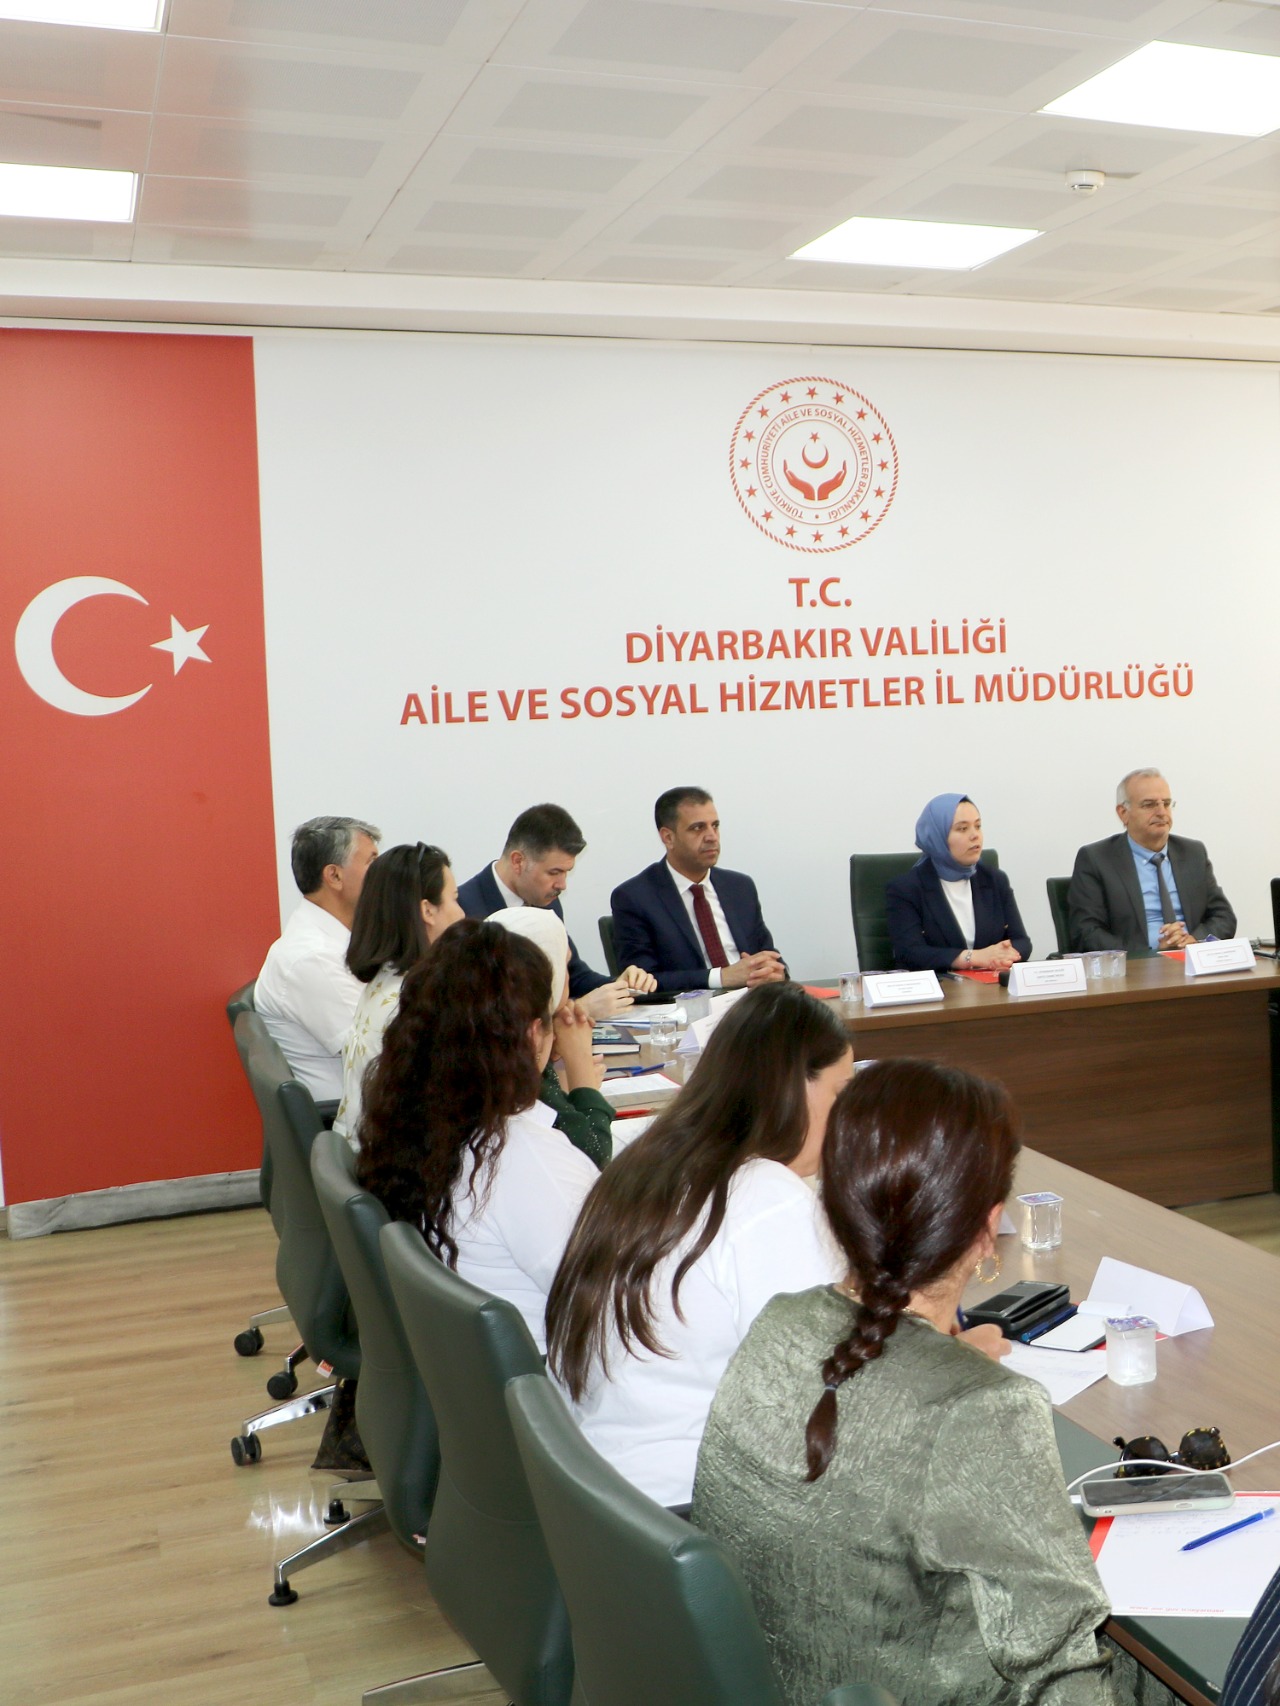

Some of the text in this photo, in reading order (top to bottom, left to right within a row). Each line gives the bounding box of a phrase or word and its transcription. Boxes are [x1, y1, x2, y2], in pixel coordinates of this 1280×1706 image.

[761, 408, 869, 519] TÜRKİYE CUMHURİYETİ AİLE VE SOSYAL HİZMETLER BAKANLIĞI
[788, 577, 852, 608] T.C.
[625, 618, 1007, 664] DİYARBAKIR VALİLİĞİ
[400, 663, 1194, 726] AİLE VE SOSYAL HİZMETLER İL MÜDÜRLÜĞÜ
